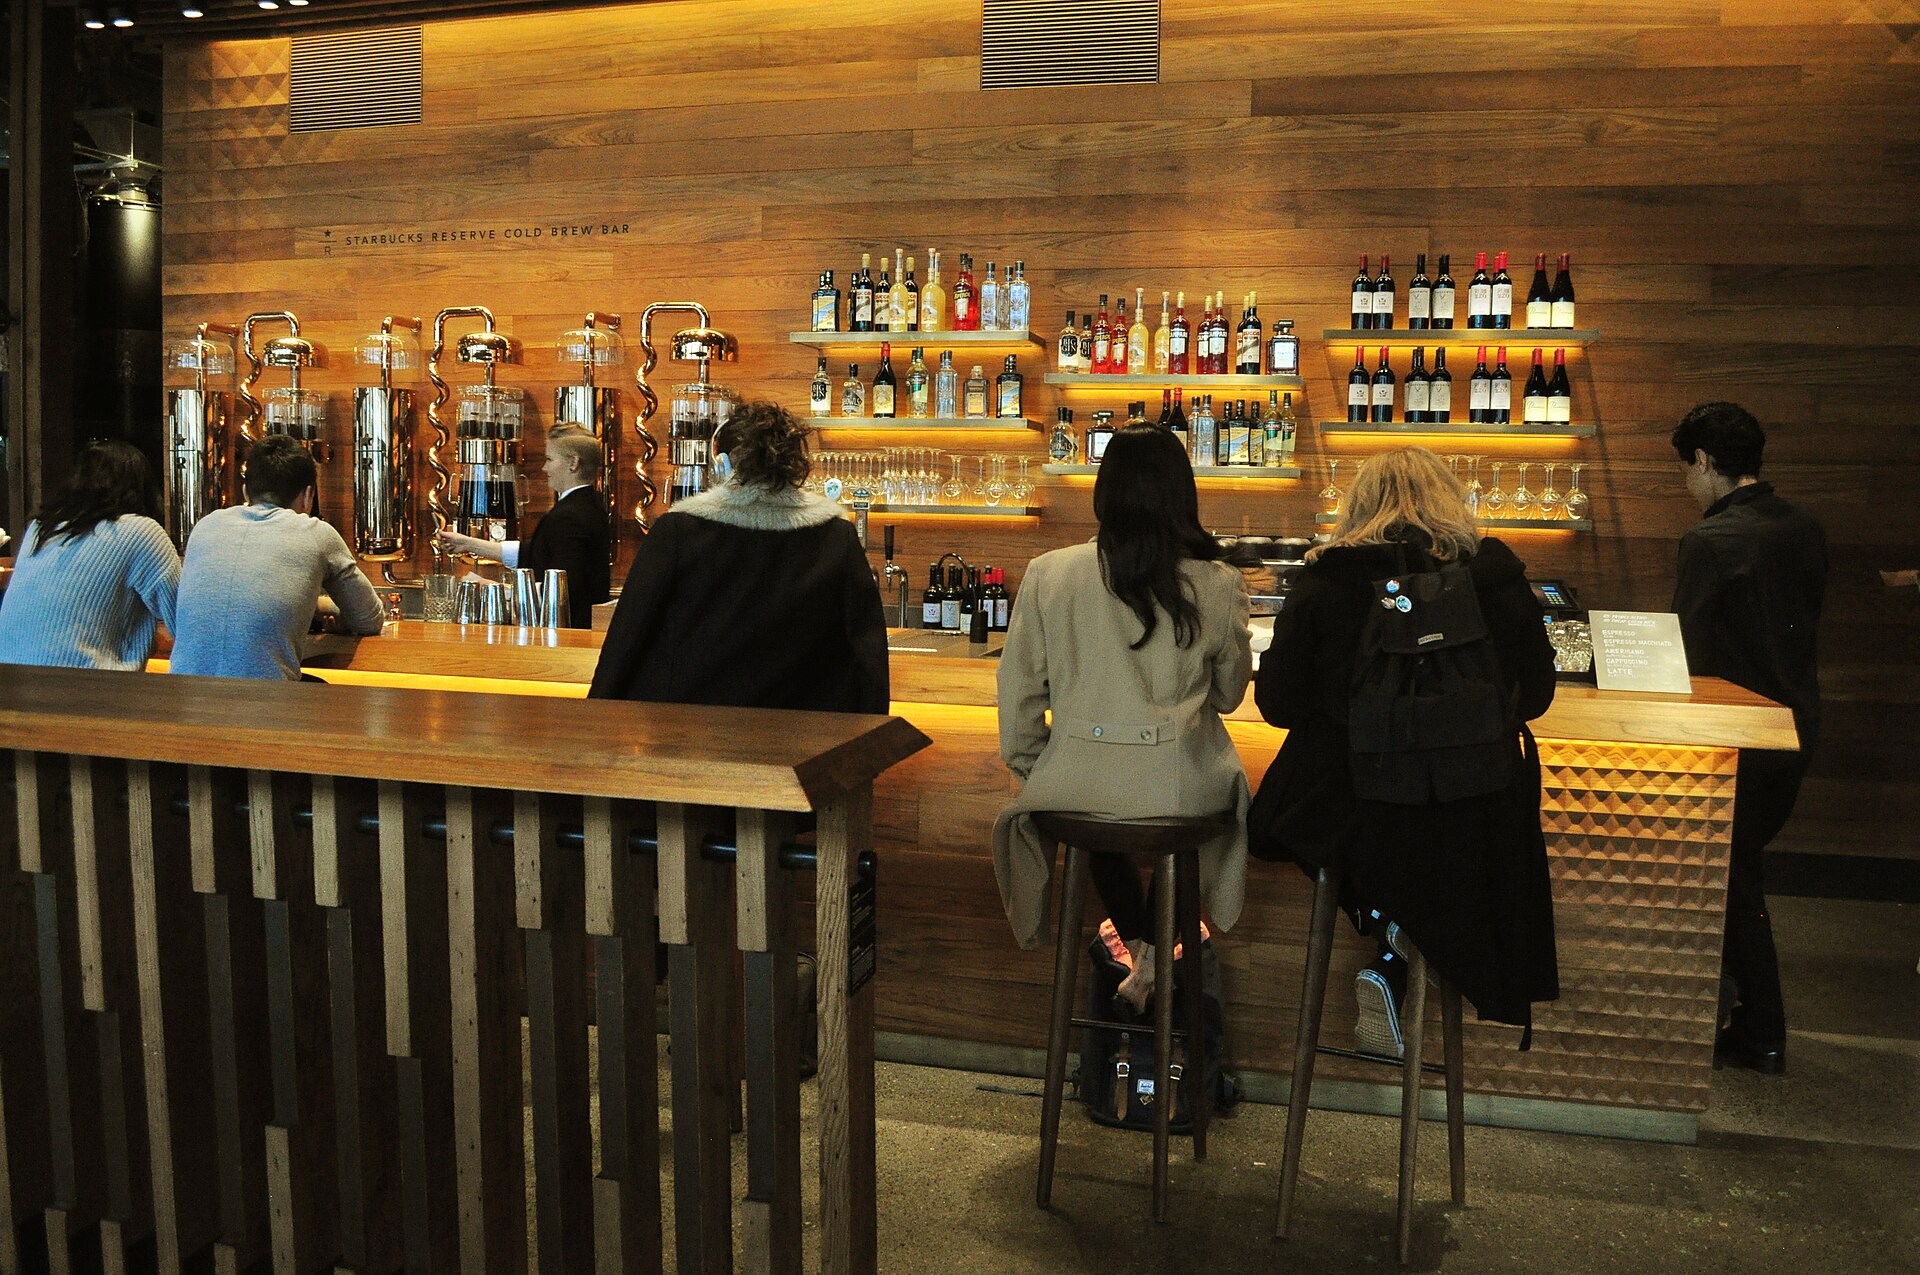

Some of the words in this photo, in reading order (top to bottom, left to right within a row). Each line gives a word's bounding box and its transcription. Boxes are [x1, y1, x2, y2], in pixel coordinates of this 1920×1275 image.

[345, 232, 423, 245] STARBUCKS
[431, 229, 496, 242] RESERVE
[504, 227, 543, 239] COLD
[551, 225, 594, 237] BREW
[601, 223, 630, 235] BAR
